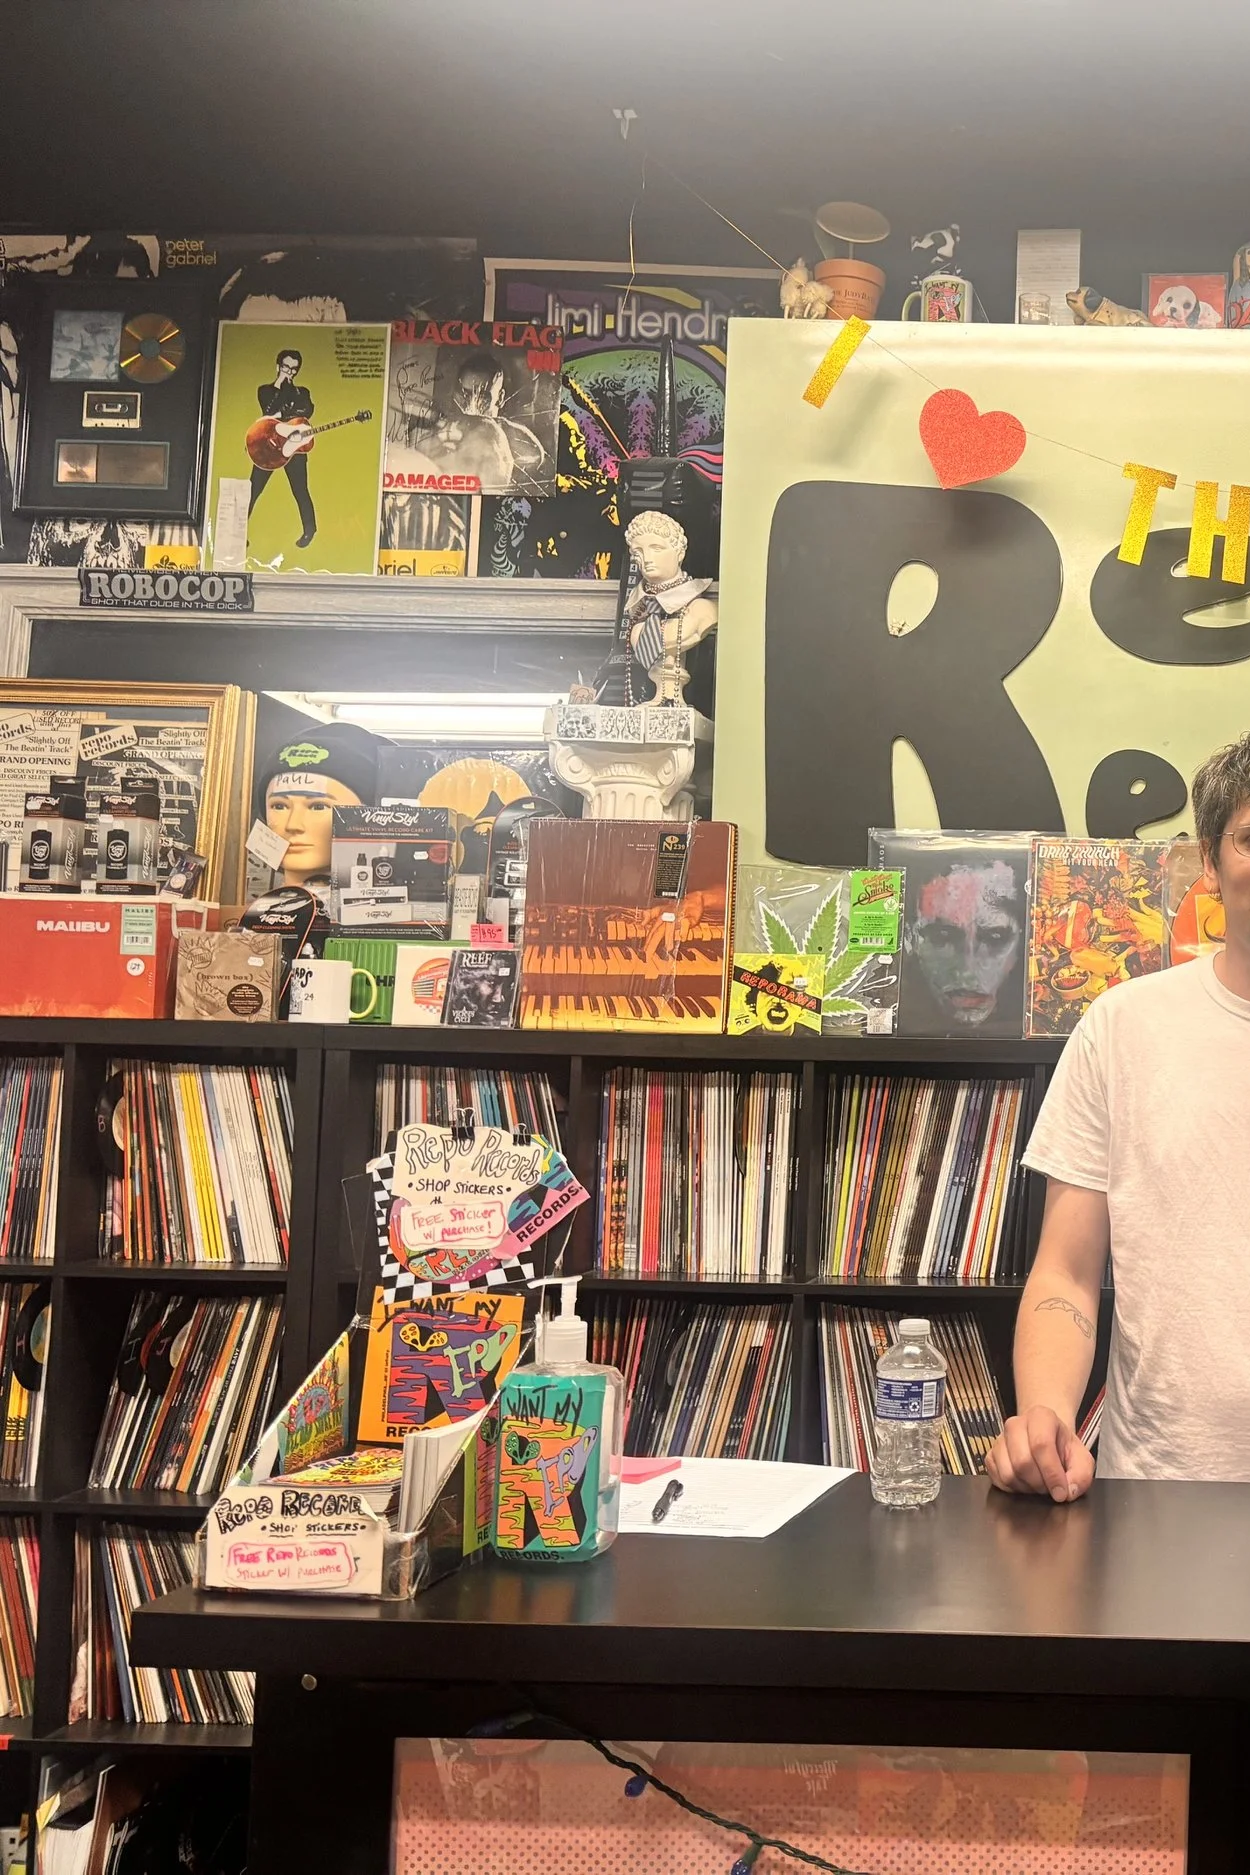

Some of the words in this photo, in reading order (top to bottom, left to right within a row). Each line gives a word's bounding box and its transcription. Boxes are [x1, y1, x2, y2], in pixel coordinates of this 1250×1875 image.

[165, 238, 205, 254] peter
[165, 250, 218, 268] gabriel
[391, 320, 482, 346] BLACK
[492, 322, 563, 349] FLAG
[382, 472, 481, 492] DAMAGED
[88, 572, 245, 603] ROBOCOP
[91, 598, 119, 606] SHOT
[121, 599, 147, 607] THAT
[149, 600, 180, 608] DUDE
[193, 602, 215, 610] THE
[217, 602, 243, 611] DICK
[4, 743, 20, 751] The
[81, 734, 111, 751] repo
[83, 734, 135, 758] records
[28, 757, 72, 766] OPENING
[1038, 844, 1073, 859] DRUG
[1073, 845, 1121, 860] CHURCH
[1062, 859, 1077, 868] HIT
[1077, 859, 1099, 868] YOUR
[1099, 859, 1120, 868] HEAD
[36, 919, 111, 933] MALIBU
[460, 951, 493, 968] REEF
[304, 992, 314, 1001] 24
[740, 971, 817, 1010] REPORAMA
[401, 1127, 475, 1175] Repo
[471, 1129, 541, 1186] Records
[415, 1179, 451, 1192] SHOP
[411, 1210, 443, 1229] FREE
[474, 1298, 502, 1331] MY
[507, 1384, 558, 1426] WANT
[553, 1387, 583, 1437] MY
[232, 1546, 261, 1566] FREE
